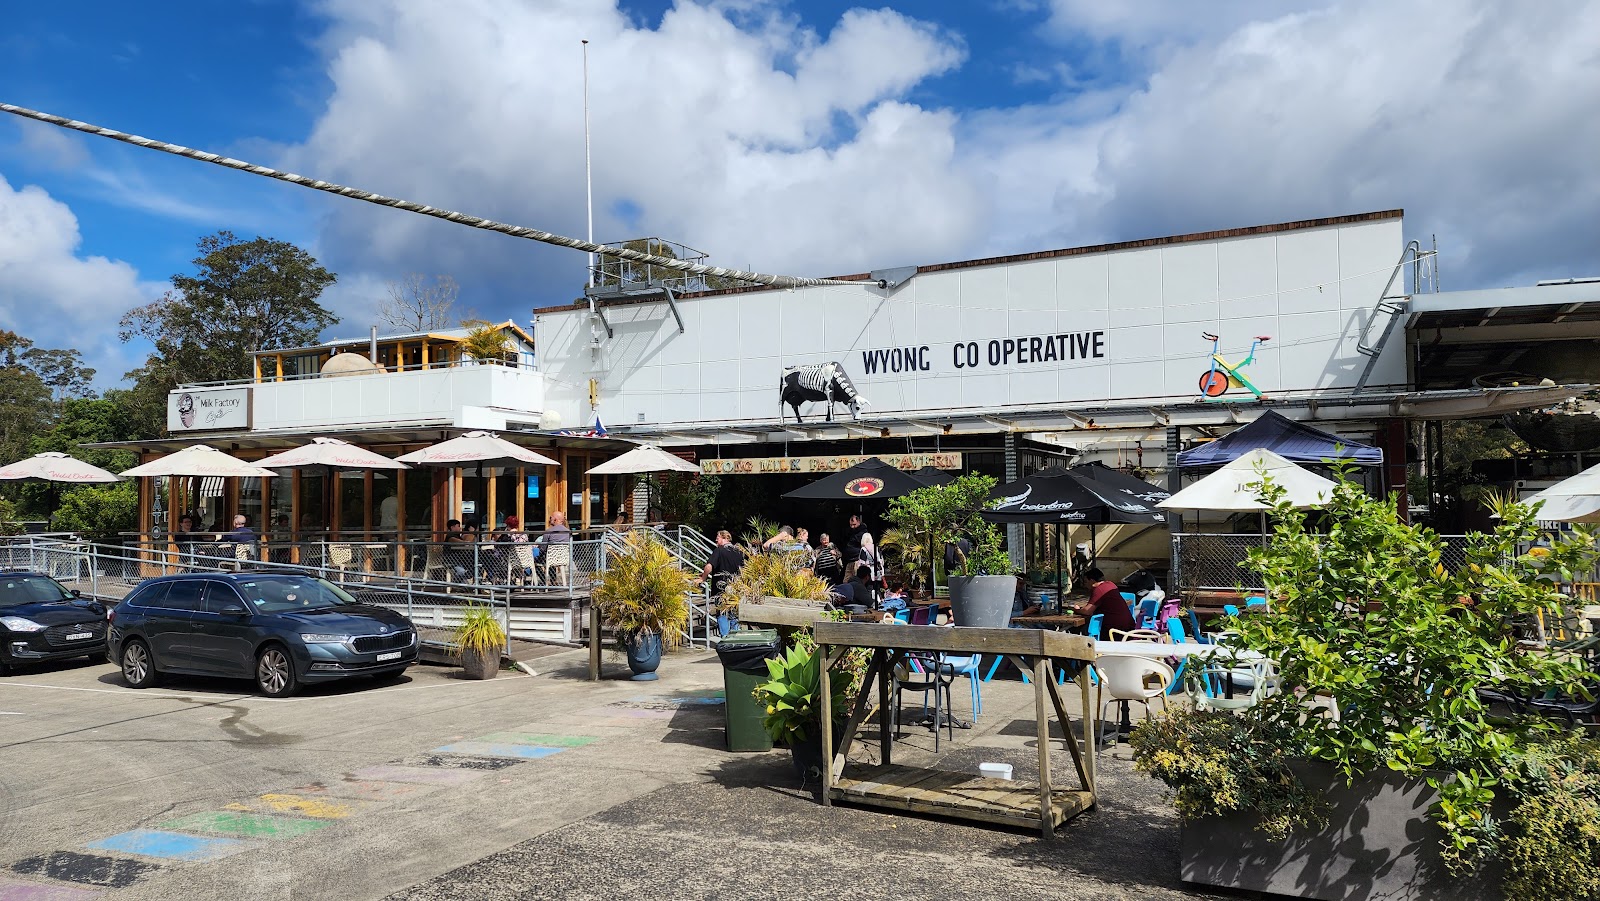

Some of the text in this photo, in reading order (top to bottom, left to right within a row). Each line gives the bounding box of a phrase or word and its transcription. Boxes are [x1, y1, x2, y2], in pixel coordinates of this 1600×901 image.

[863, 331, 1104, 375] WYONG CO OPERATIVE
[201, 398, 240, 408] Milk Factory
[702, 460, 753, 473] WYONG
[760, 459, 801, 472] MILK
[809, 456, 870, 472] FACTO
[889, 455, 958, 470] TAVERN
